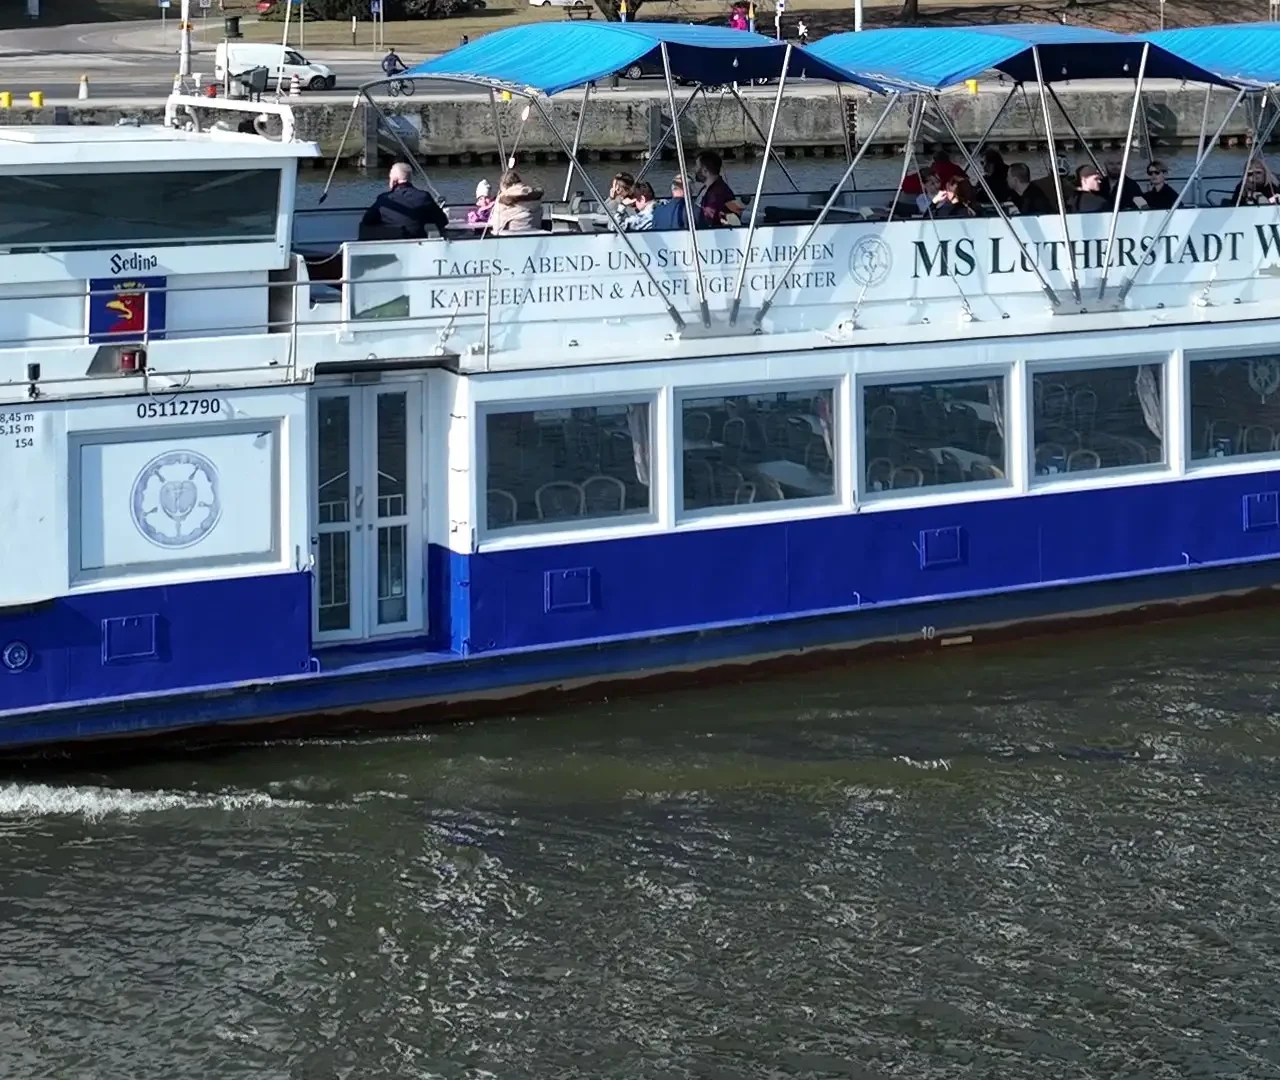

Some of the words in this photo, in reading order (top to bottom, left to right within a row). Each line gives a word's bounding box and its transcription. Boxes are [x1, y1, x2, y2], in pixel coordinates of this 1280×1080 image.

[110, 252, 158, 274] Sedina
[521, 255, 601, 275] ABEND-
[608, 251, 651, 270] UND
[657, 243, 835, 268] STUNDENFAHRTEN
[911, 237, 976, 278] MS
[988, 231, 1244, 274] LUTHERSTADT
[430, 282, 604, 309] KAFFEEFAHRTEN
[609, 283, 625, 299] &
[750, 271, 837, 290] CHARTER
[24, 413, 34, 421] m
[137, 398, 221, 419] 05112790
[0, 424, 21, 436] 5,15
[24, 425, 34, 433] m
[15, 438, 34, 448] 154
[921, 626, 935, 640] 10
